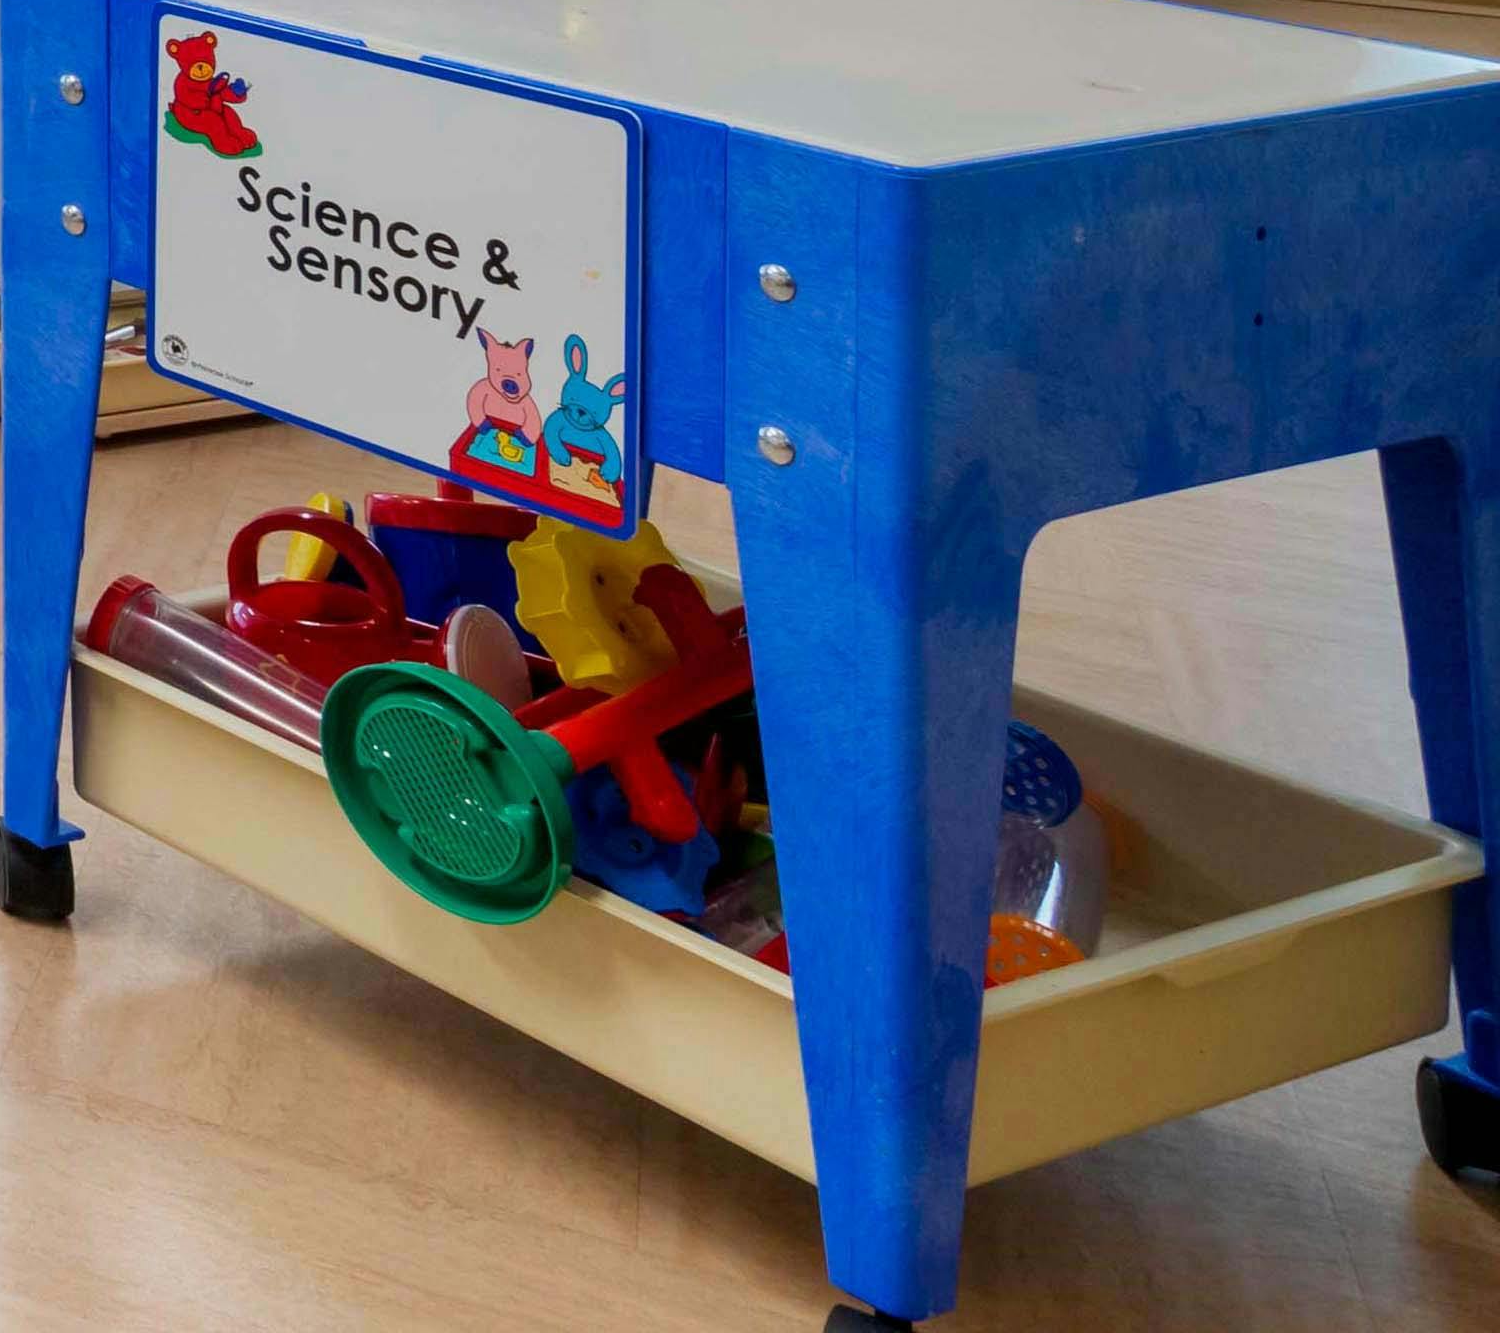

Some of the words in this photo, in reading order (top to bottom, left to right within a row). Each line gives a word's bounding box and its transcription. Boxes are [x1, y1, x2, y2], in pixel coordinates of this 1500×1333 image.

[236, 166, 460, 270] Science
[482, 239, 521, 291] &
[267, 225, 486, 340] Sensory
